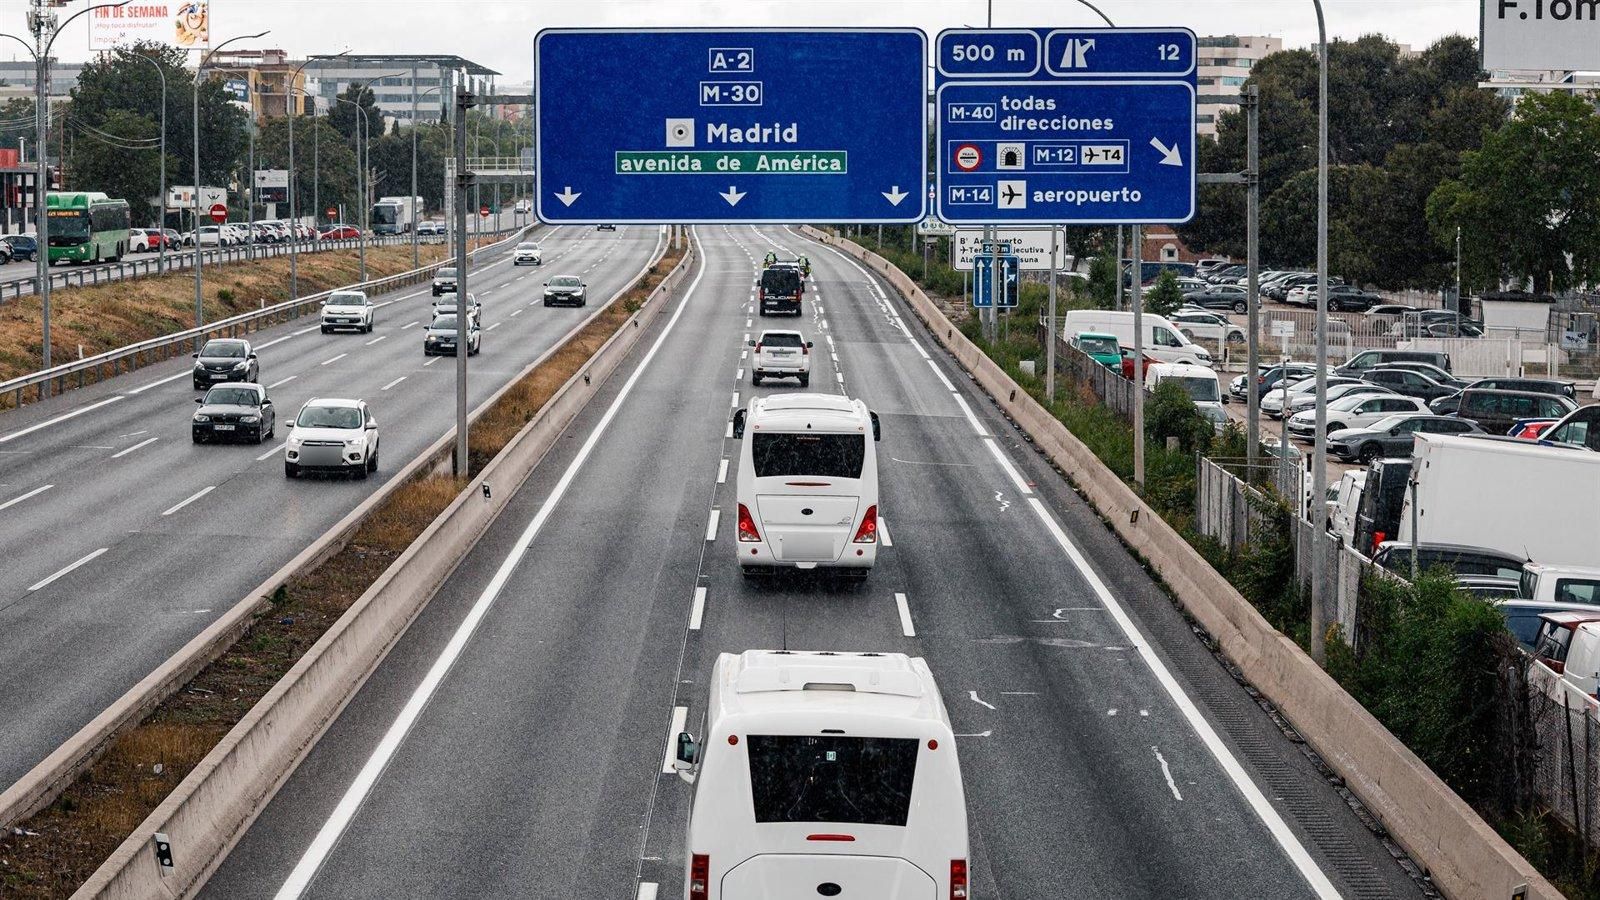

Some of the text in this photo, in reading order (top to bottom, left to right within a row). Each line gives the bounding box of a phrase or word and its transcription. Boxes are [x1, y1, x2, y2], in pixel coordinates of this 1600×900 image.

[95, 6, 169, 18] FIN DE SEMANA
[712, 52, 750, 69] A-2
[953, 45, 1025, 61] 500 m
[1158, 44, 1180, 61] 12
[703, 86, 760, 102] M-30
[1001, 95, 1057, 111] todas
[952, 107, 994, 119] M-40
[1000, 115, 1114, 131] direcciones
[707, 123, 798, 143] Madrid
[620, 155, 842, 171] avenida de América
[1036, 149, 1122, 161] M-12 T4
[952, 187, 1142, 206] M-14 aeropuerto
